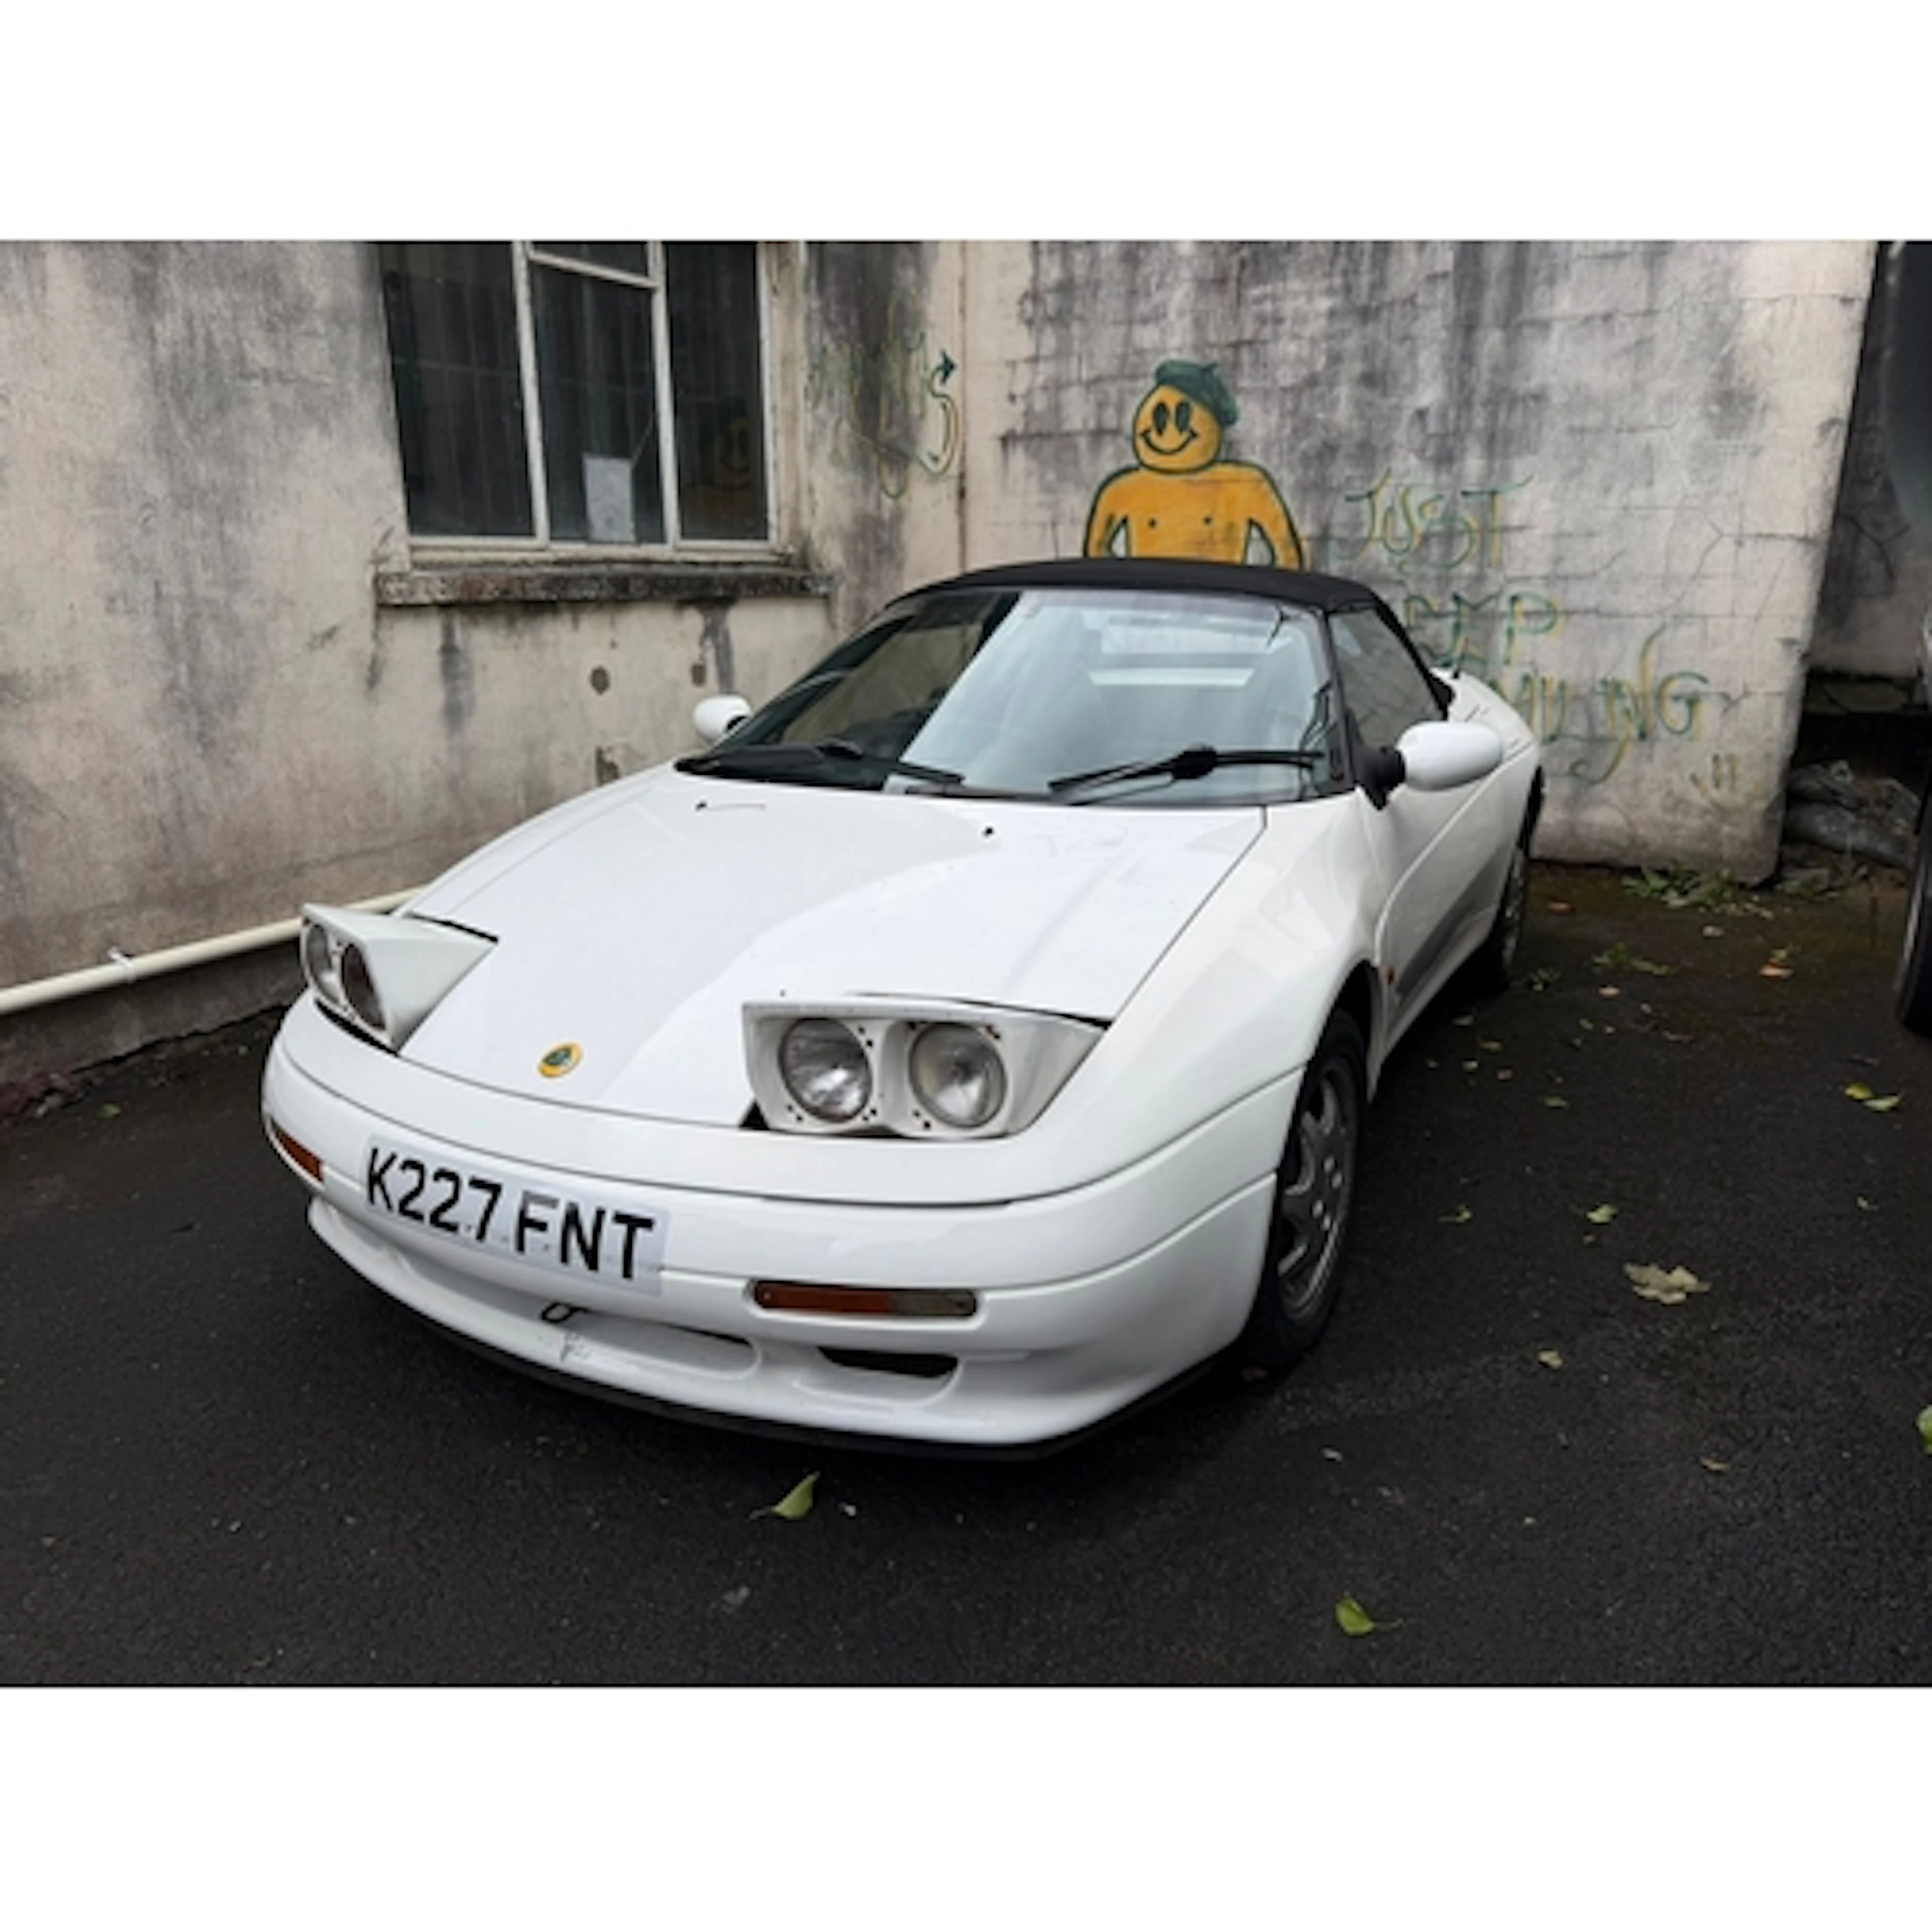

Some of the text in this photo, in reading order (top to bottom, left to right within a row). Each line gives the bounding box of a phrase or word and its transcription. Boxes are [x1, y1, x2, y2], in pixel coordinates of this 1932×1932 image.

[1328, 468, 1535, 574] JUST
[1405, 590, 1564, 672] EEP
[1488, 624, 1710, 784] MILING
[369, 1148, 655, 1279] K227 FNT
